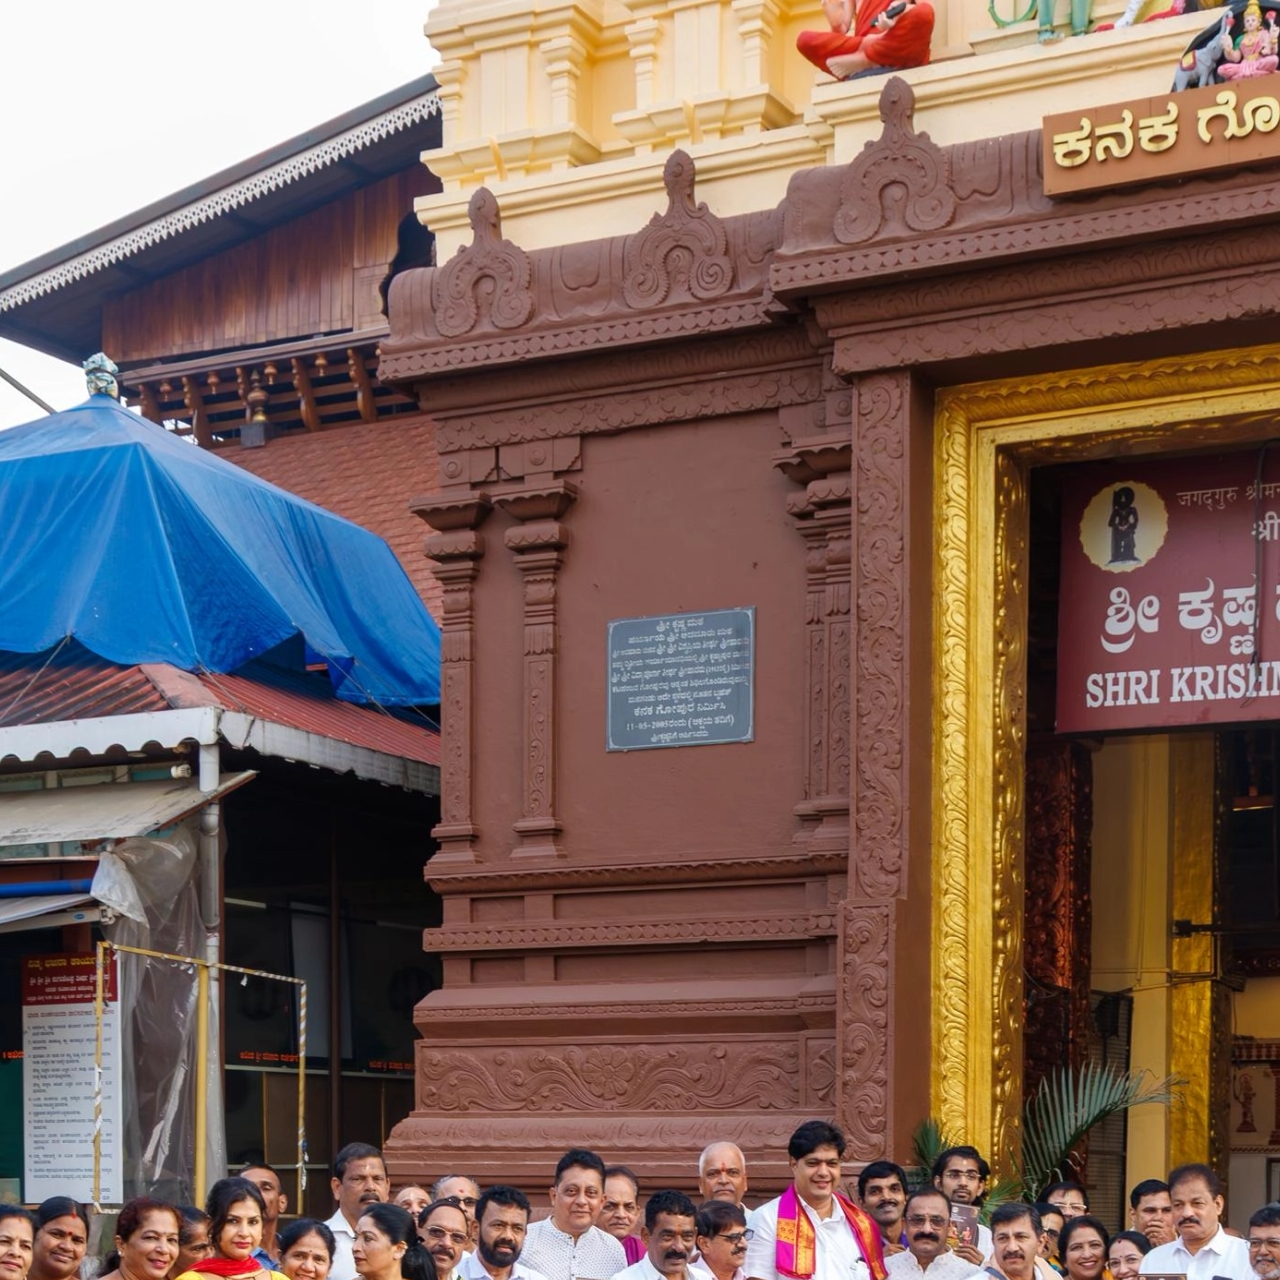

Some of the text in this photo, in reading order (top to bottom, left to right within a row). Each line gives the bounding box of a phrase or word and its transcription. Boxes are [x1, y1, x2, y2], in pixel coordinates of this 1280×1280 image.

[1052, 101, 1179, 168] ಕನಕ
[1100, 586, 1159, 654] ಶ್ರೀ
[1178, 576, 1258, 655] ಕೃಷ್ಣ
[1085, 668, 1161, 708] SHRI
